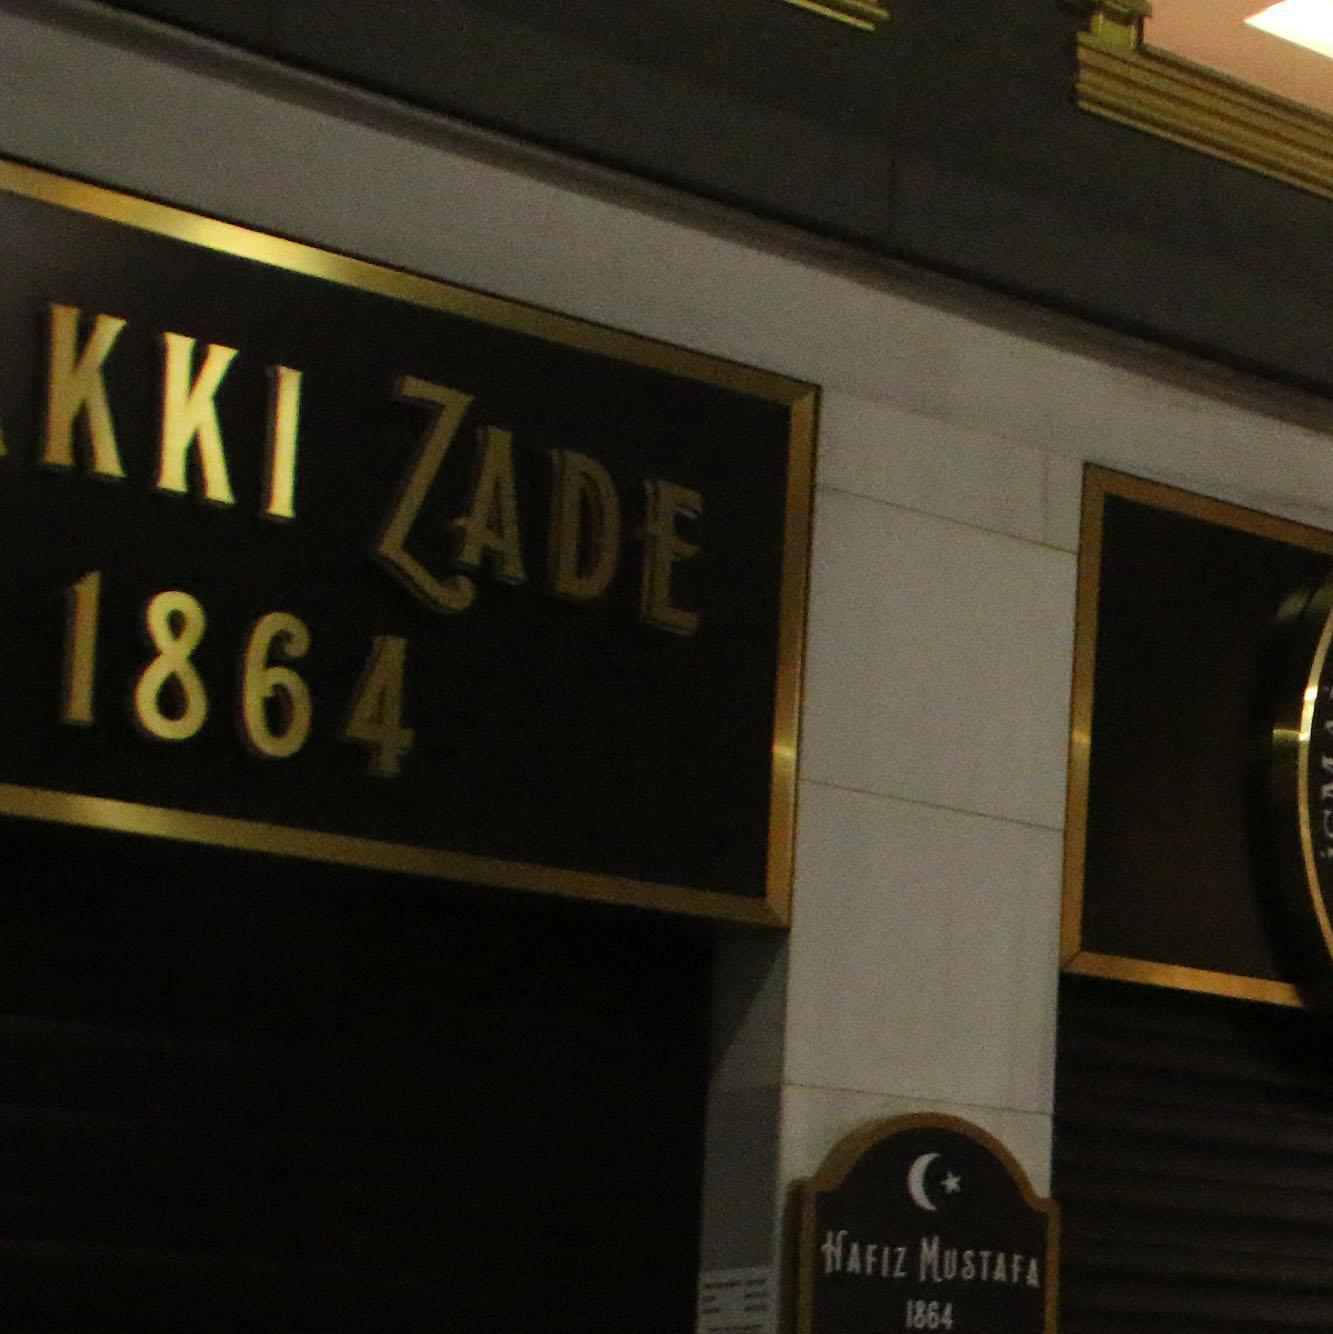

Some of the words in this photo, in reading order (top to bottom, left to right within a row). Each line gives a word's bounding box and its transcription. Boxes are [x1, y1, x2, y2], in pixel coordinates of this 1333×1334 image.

[0, 303, 304, 520] KKI
[370, 374, 704, 636] ZADE
[60, 569, 416, 779] 1864
[822, 1230, 908, 1279] HAFIZ
[919, 1233, 1040, 1288] MUSTAFA
[905, 1299, 954, 1330] 1864
